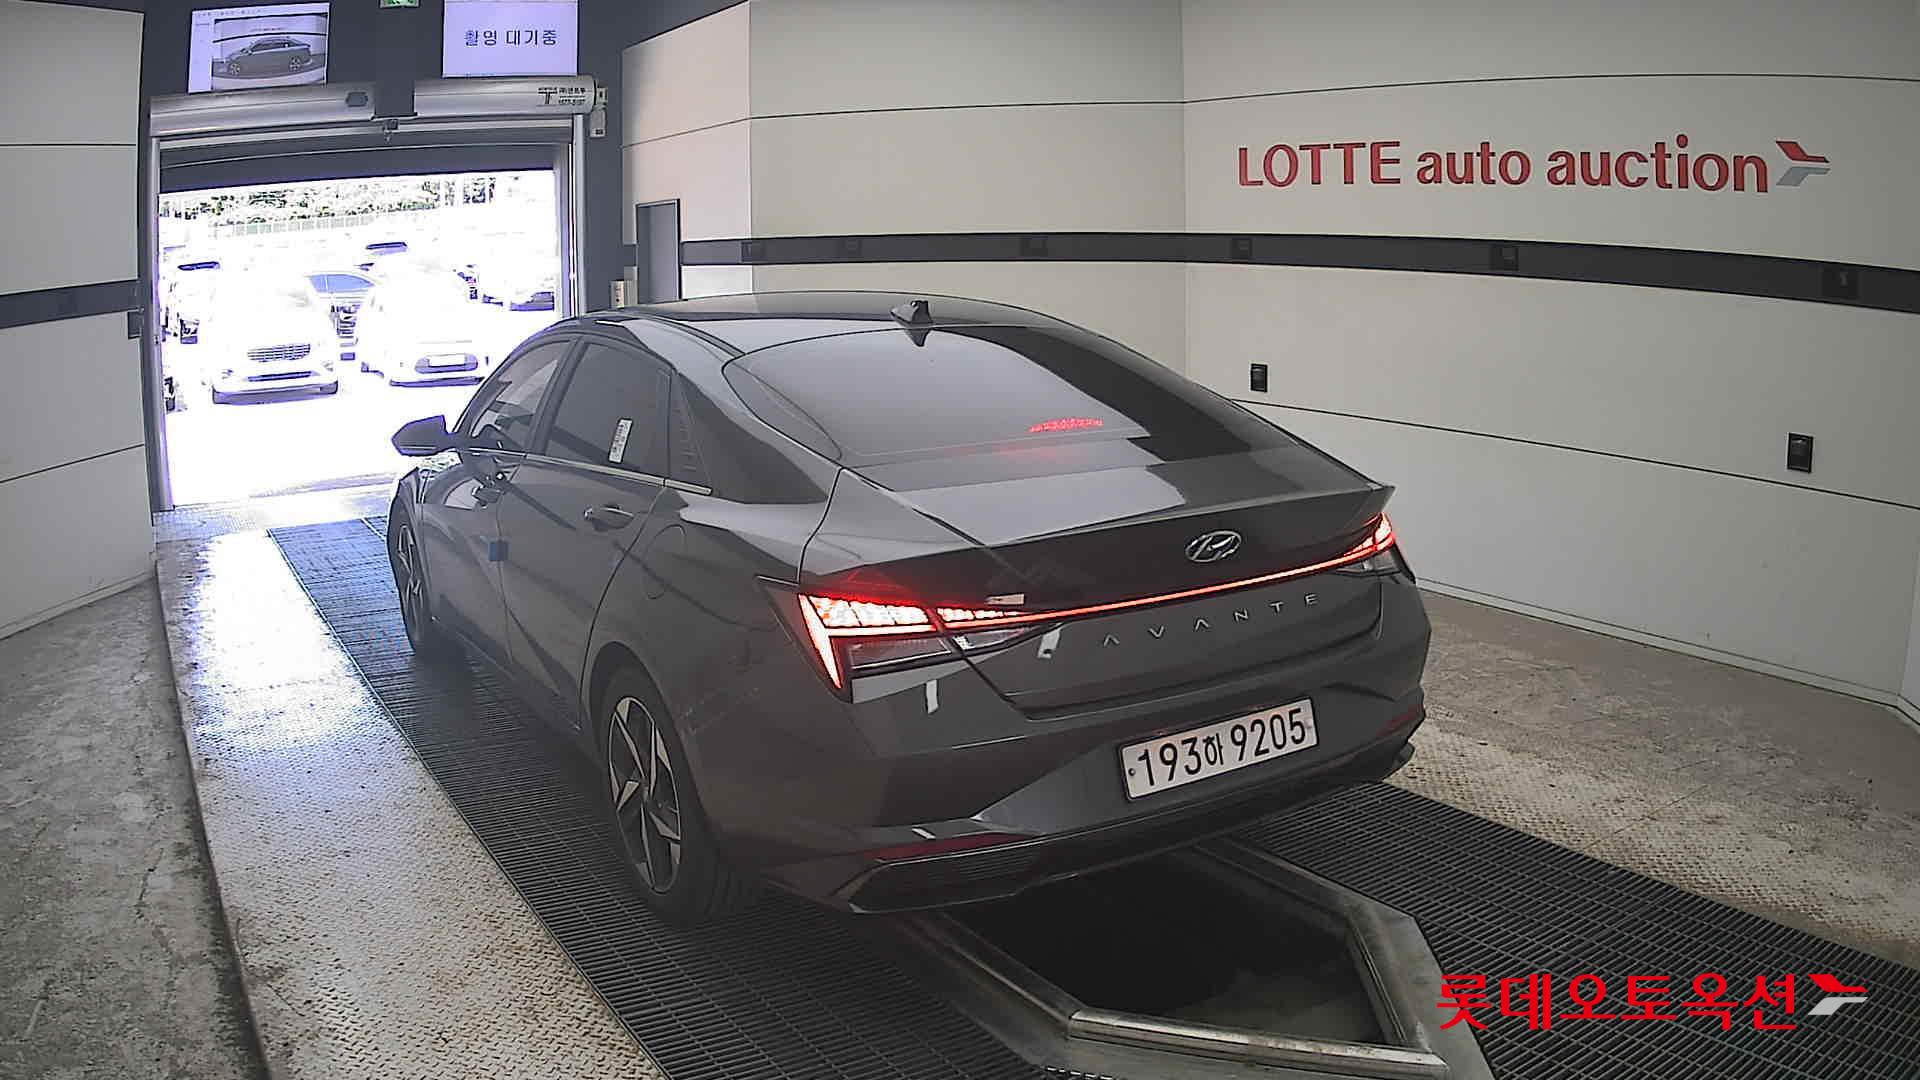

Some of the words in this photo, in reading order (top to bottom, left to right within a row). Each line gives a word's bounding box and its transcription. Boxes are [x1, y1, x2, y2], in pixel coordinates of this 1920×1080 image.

[465, 30, 497, 46] 촬영
[505, 29, 557, 46] 대기중
[1237, 140, 1400, 188] LOTTE
[1416, 142, 1532, 186] auto
[1547, 134, 1769, 193] auction
[1103, 592, 1318, 647] AVANTE
[1138, 732, 1224, 786] 193하
[1230, 708, 1306, 762] 9205
